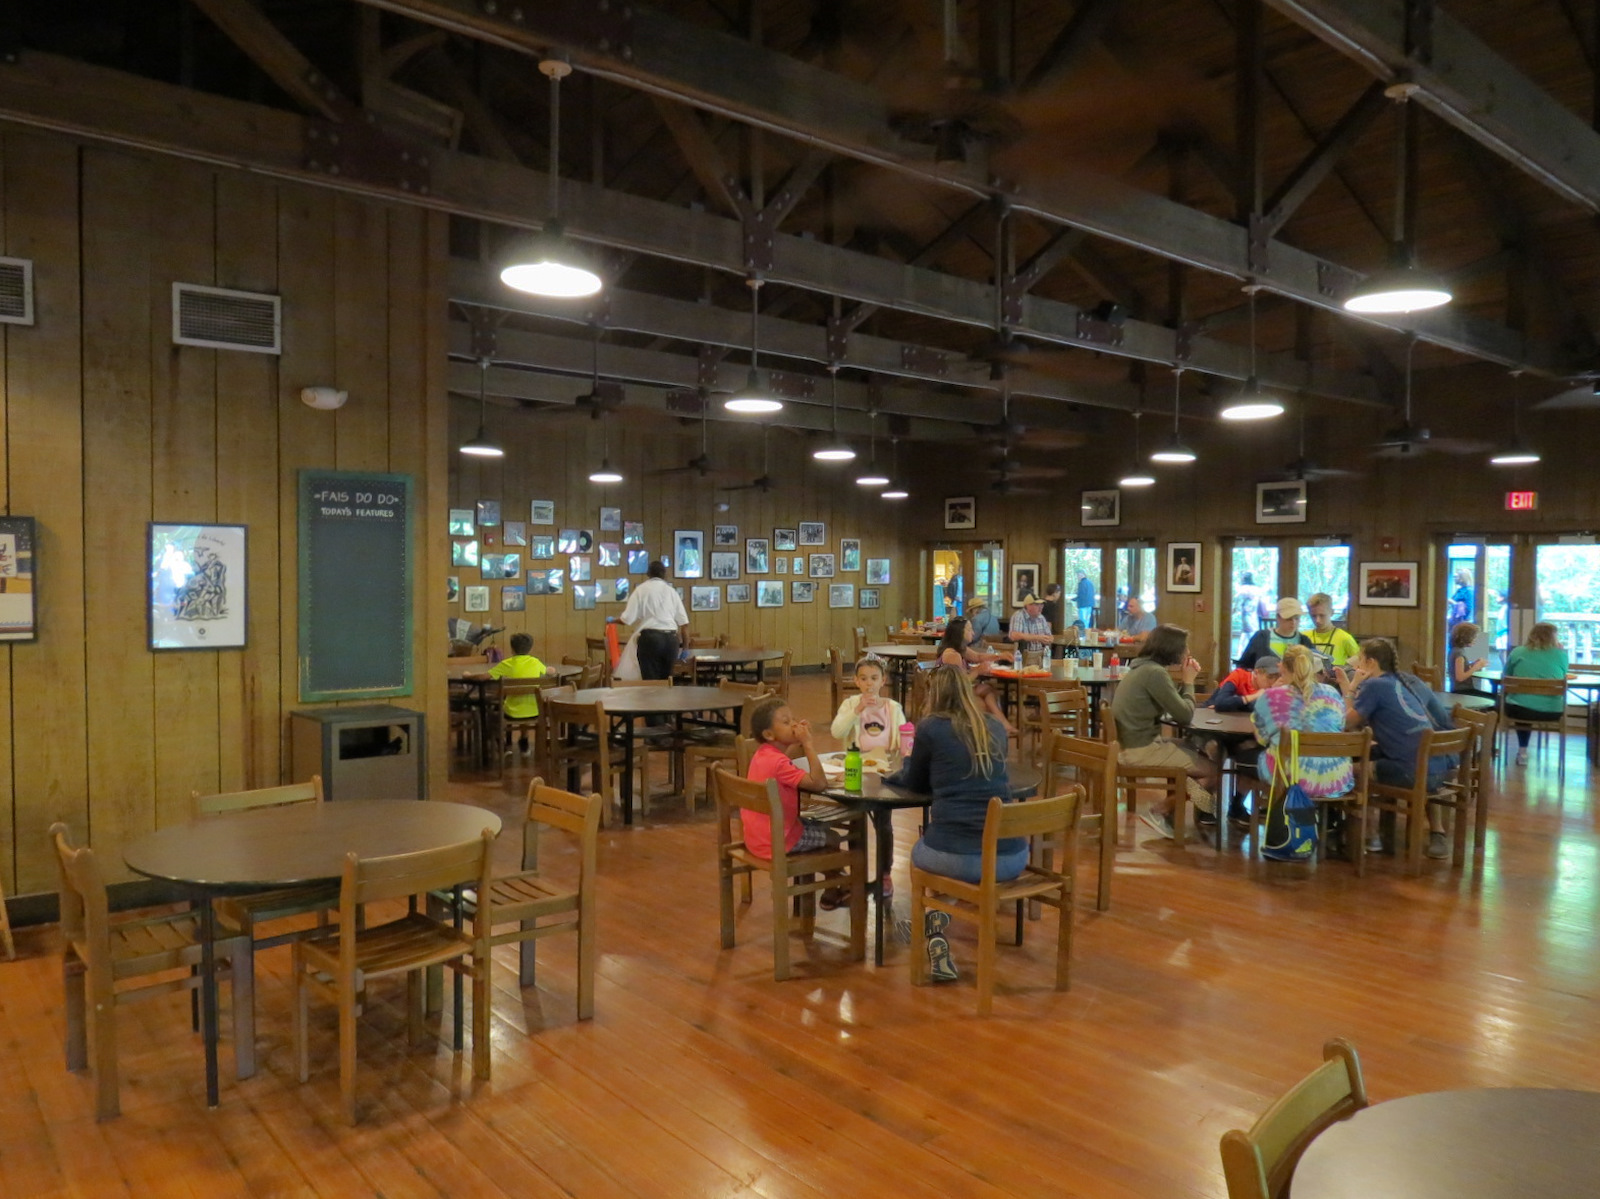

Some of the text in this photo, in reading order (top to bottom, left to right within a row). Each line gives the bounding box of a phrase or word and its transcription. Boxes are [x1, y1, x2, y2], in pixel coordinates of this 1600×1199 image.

[356, 492, 372, 503] DO
[1511, 492, 1534, 508] EXIT
[321, 507, 394, 517] TODAY'S FEATURES
